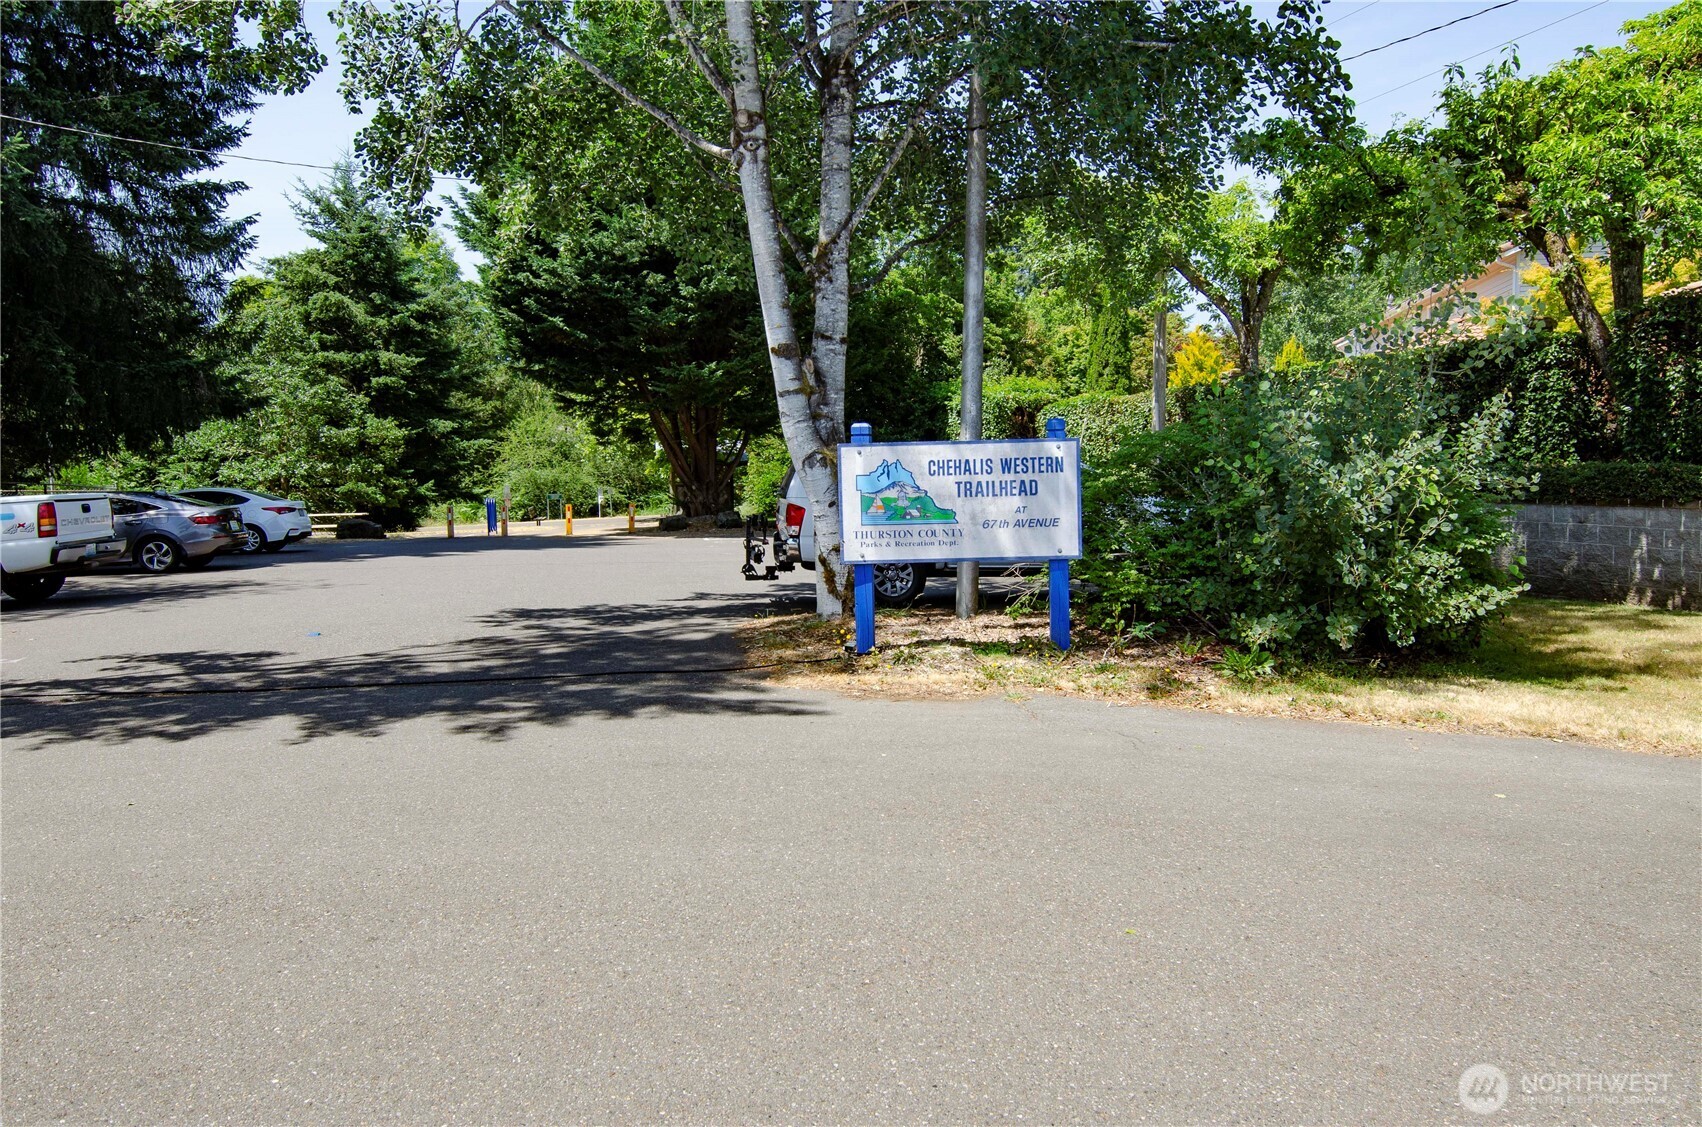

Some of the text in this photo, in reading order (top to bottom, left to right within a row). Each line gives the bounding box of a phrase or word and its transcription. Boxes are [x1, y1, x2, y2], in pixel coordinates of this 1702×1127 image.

[928, 456, 1064, 476] CHEHALIS WESTERN
[955, 479, 1039, 498] TRAILHEAD
[1014, 506, 1028, 514] AT
[60, 515, 110, 527] CHEVROLET
[982, 517, 1060, 529] 67th AVENUE
[853, 528, 965, 539] THURSTON COUNTY
[860, 540, 883, 548] Parks
[894, 539, 935, 547] Recreation
[938, 539, 959, 548] Dept.
